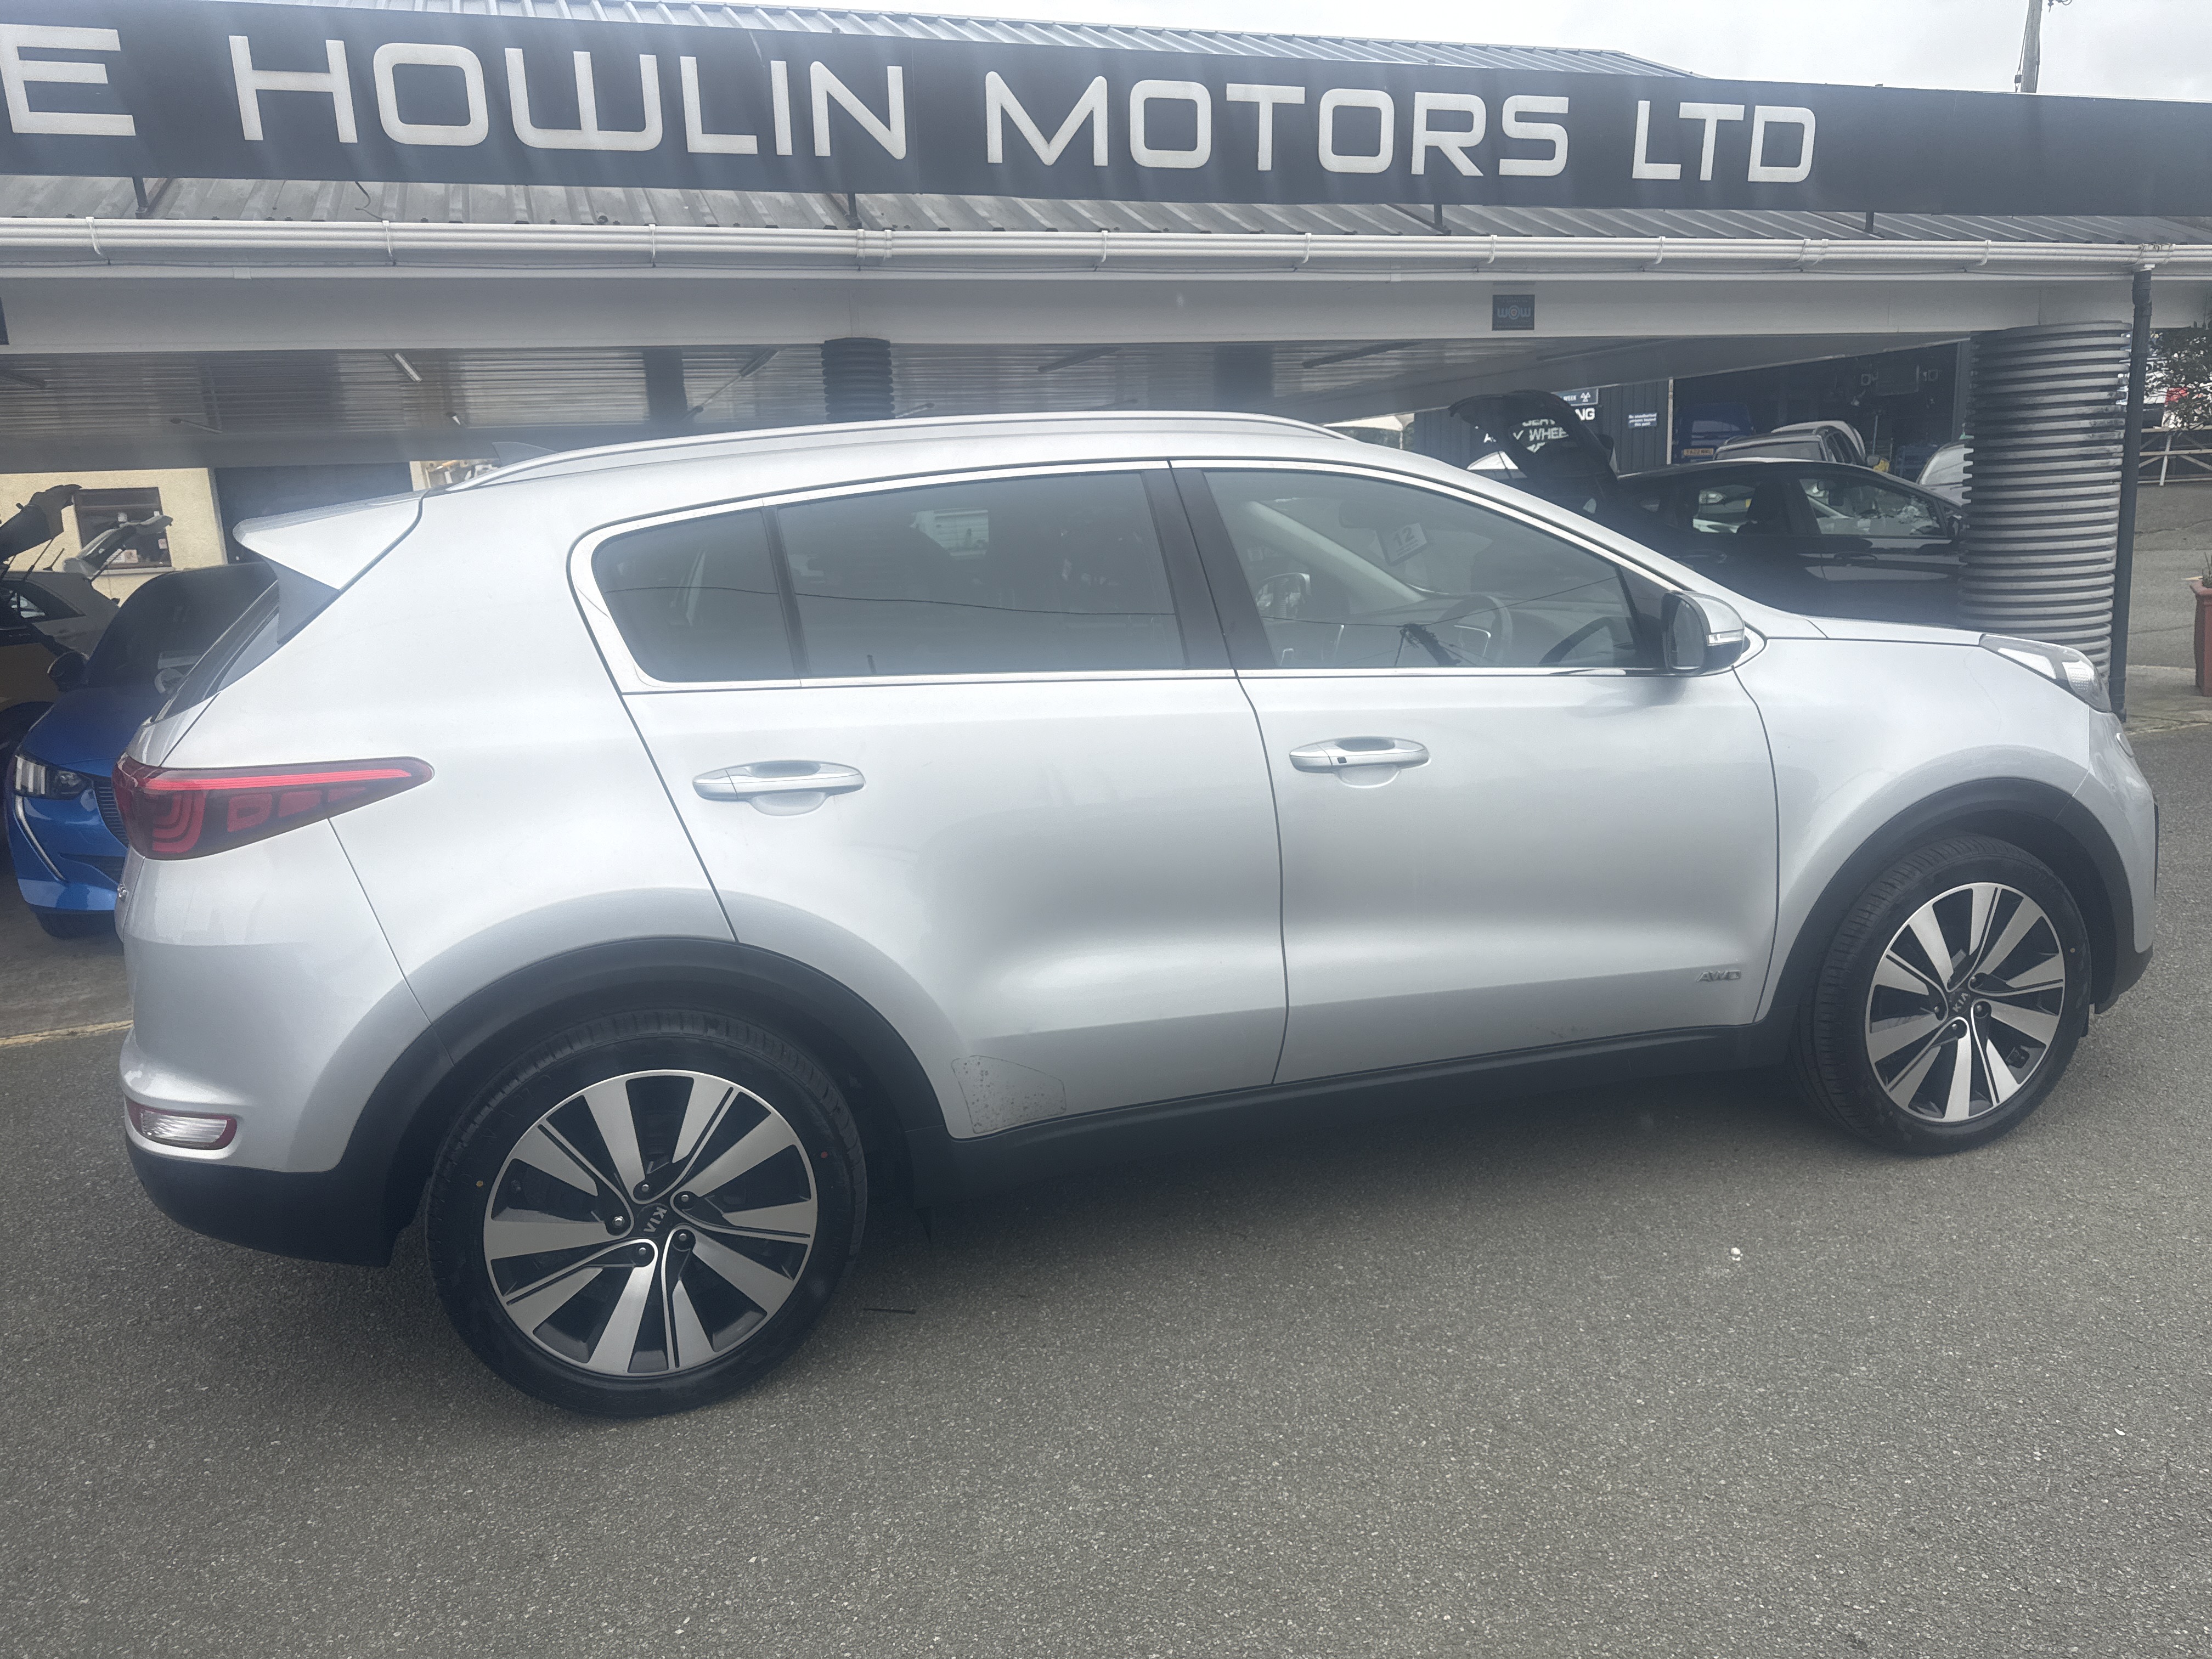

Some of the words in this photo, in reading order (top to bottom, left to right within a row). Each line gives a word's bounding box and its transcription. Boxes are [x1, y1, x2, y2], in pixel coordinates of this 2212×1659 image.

[0, 24, 137, 137] E
[228, 35, 907, 160] HOWLIN
[985, 71, 1569, 177] MOTORS
[1632, 100, 1816, 183] LTD
[1696, 970, 1742, 982] AWD
[1953, 993, 1969, 1013] KIA
[644, 1206, 668, 1232] KIA
